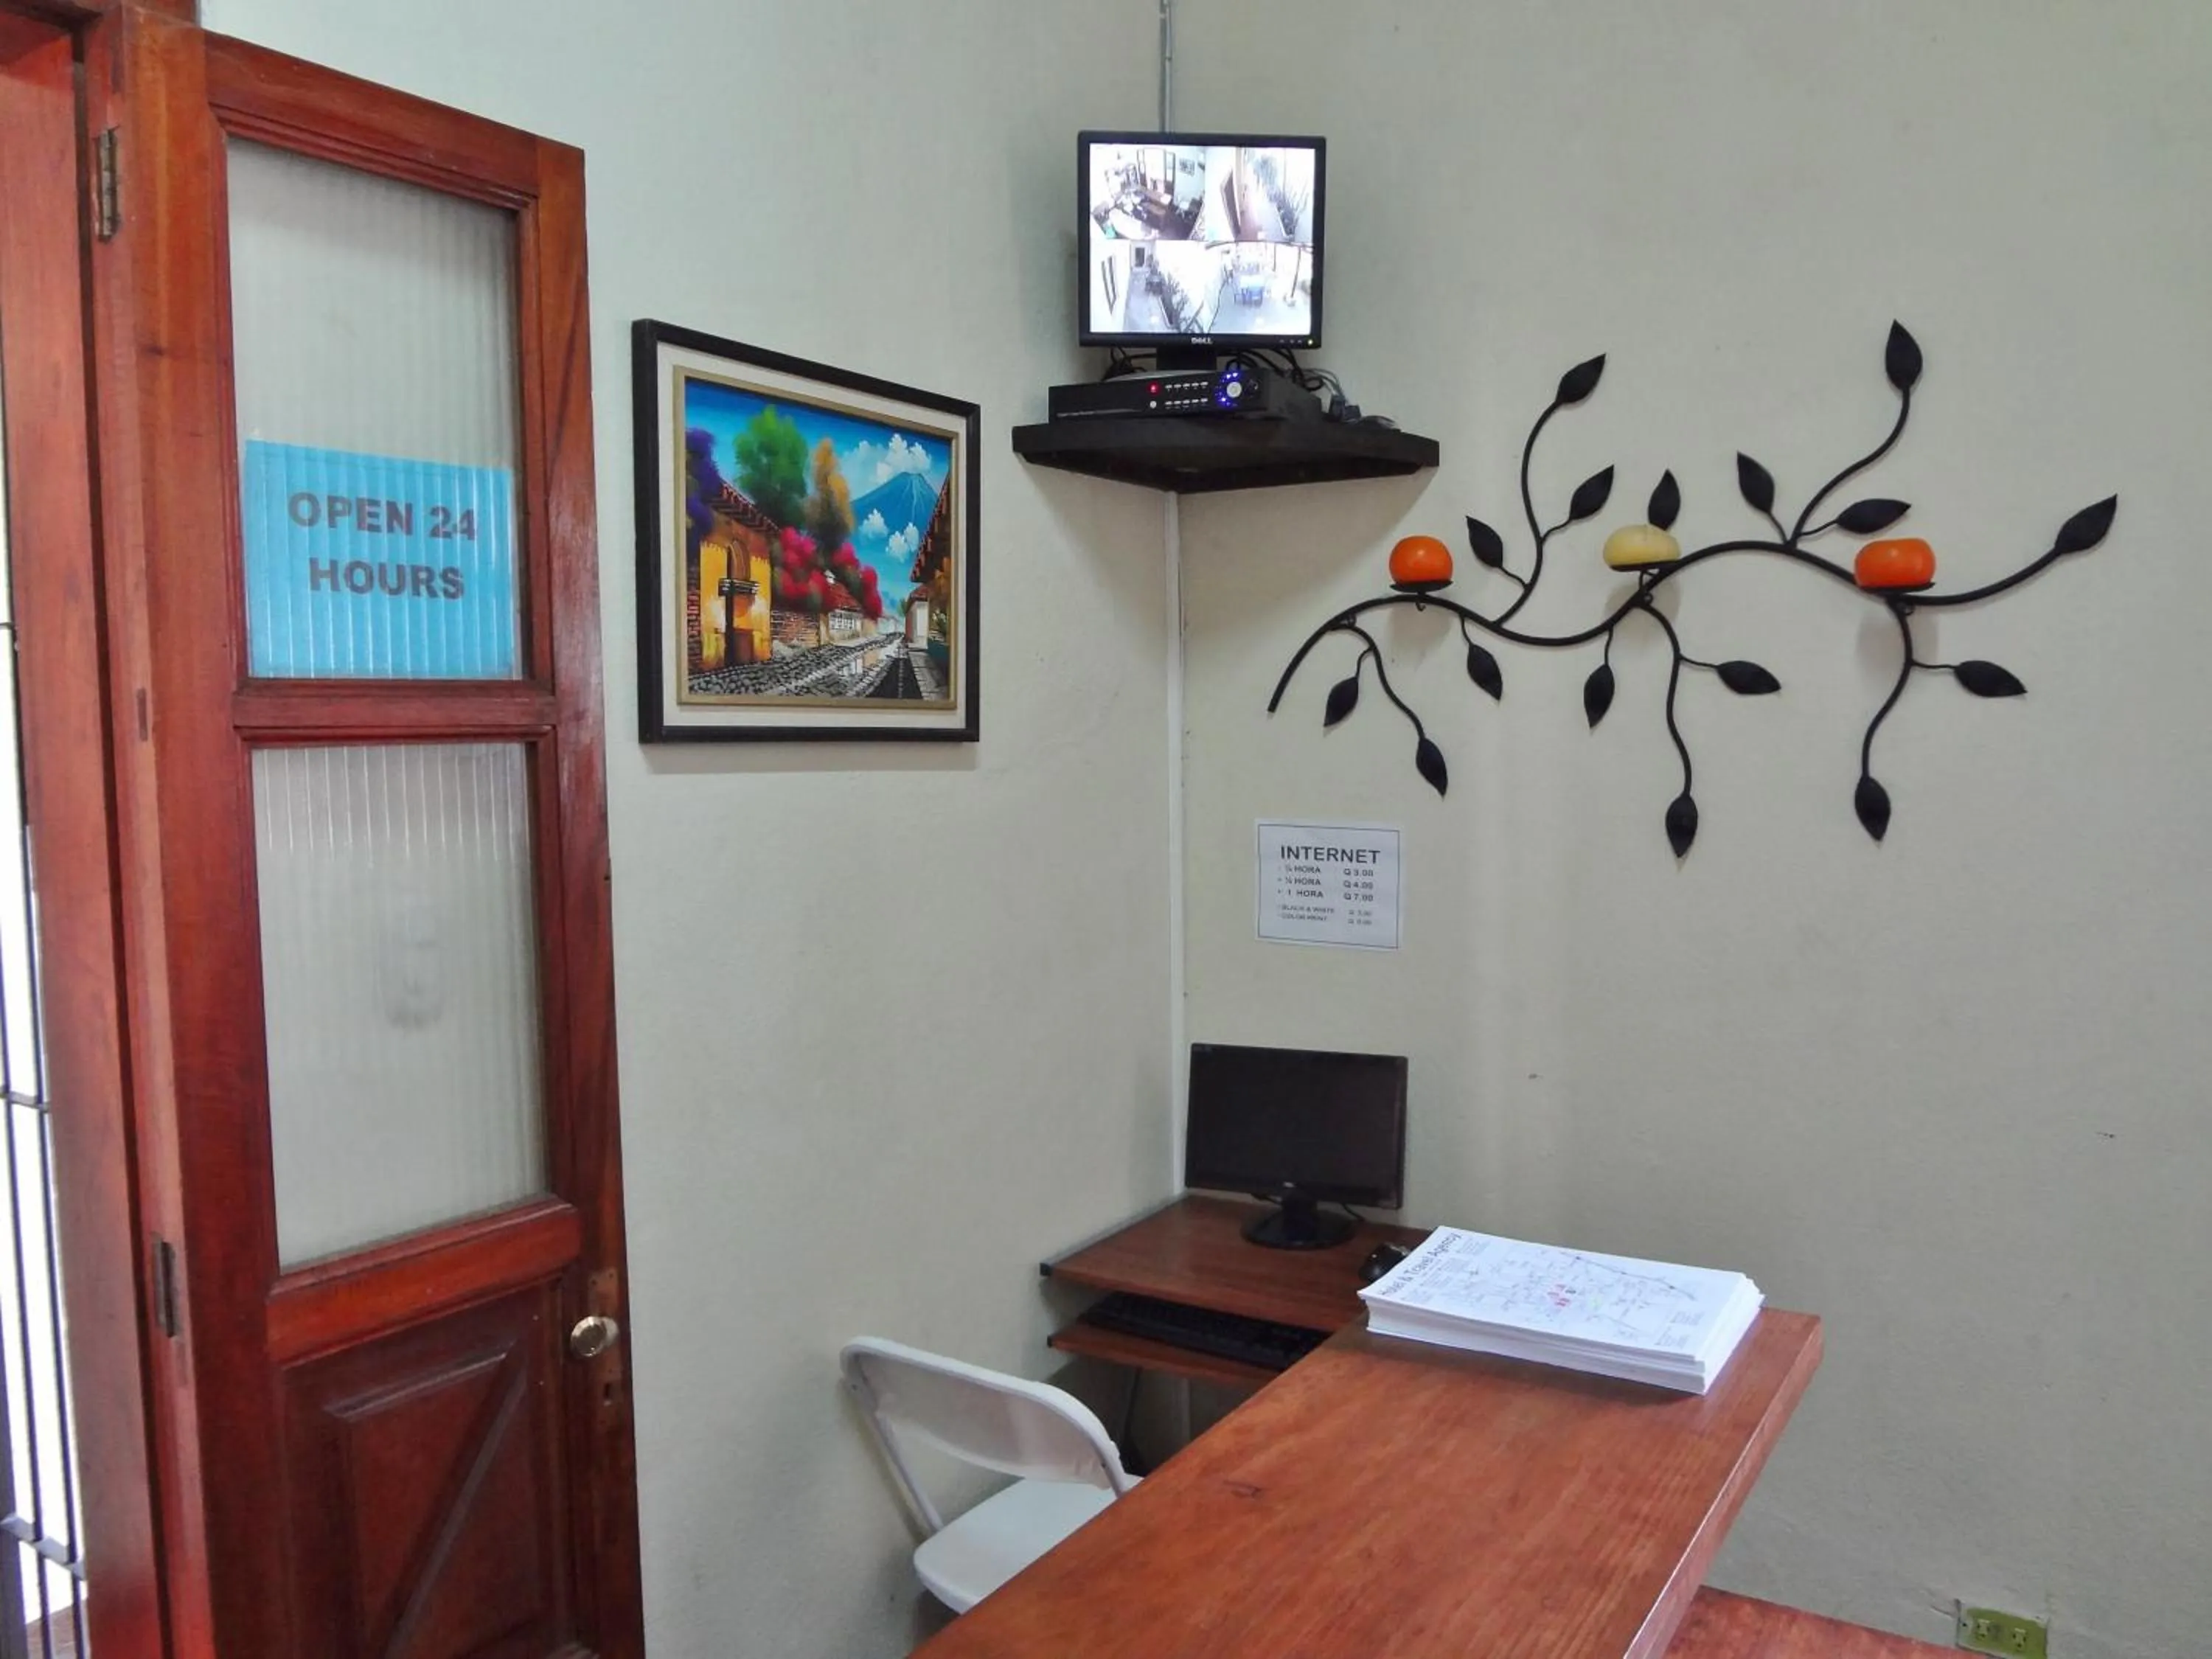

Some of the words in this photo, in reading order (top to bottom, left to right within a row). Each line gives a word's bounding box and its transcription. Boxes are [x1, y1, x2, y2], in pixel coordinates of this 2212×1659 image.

[288, 492, 413, 536] OPEN
[428, 506, 476, 540] 24
[309, 557, 465, 600] HOURS
[1281, 845, 1380, 863] INTERNET
[1294, 865, 1321, 874] HORA
[1294, 877, 1321, 886] HORA
[1296, 889, 1324, 898] HORA
[1354, 893, 1374, 902] 7.00
